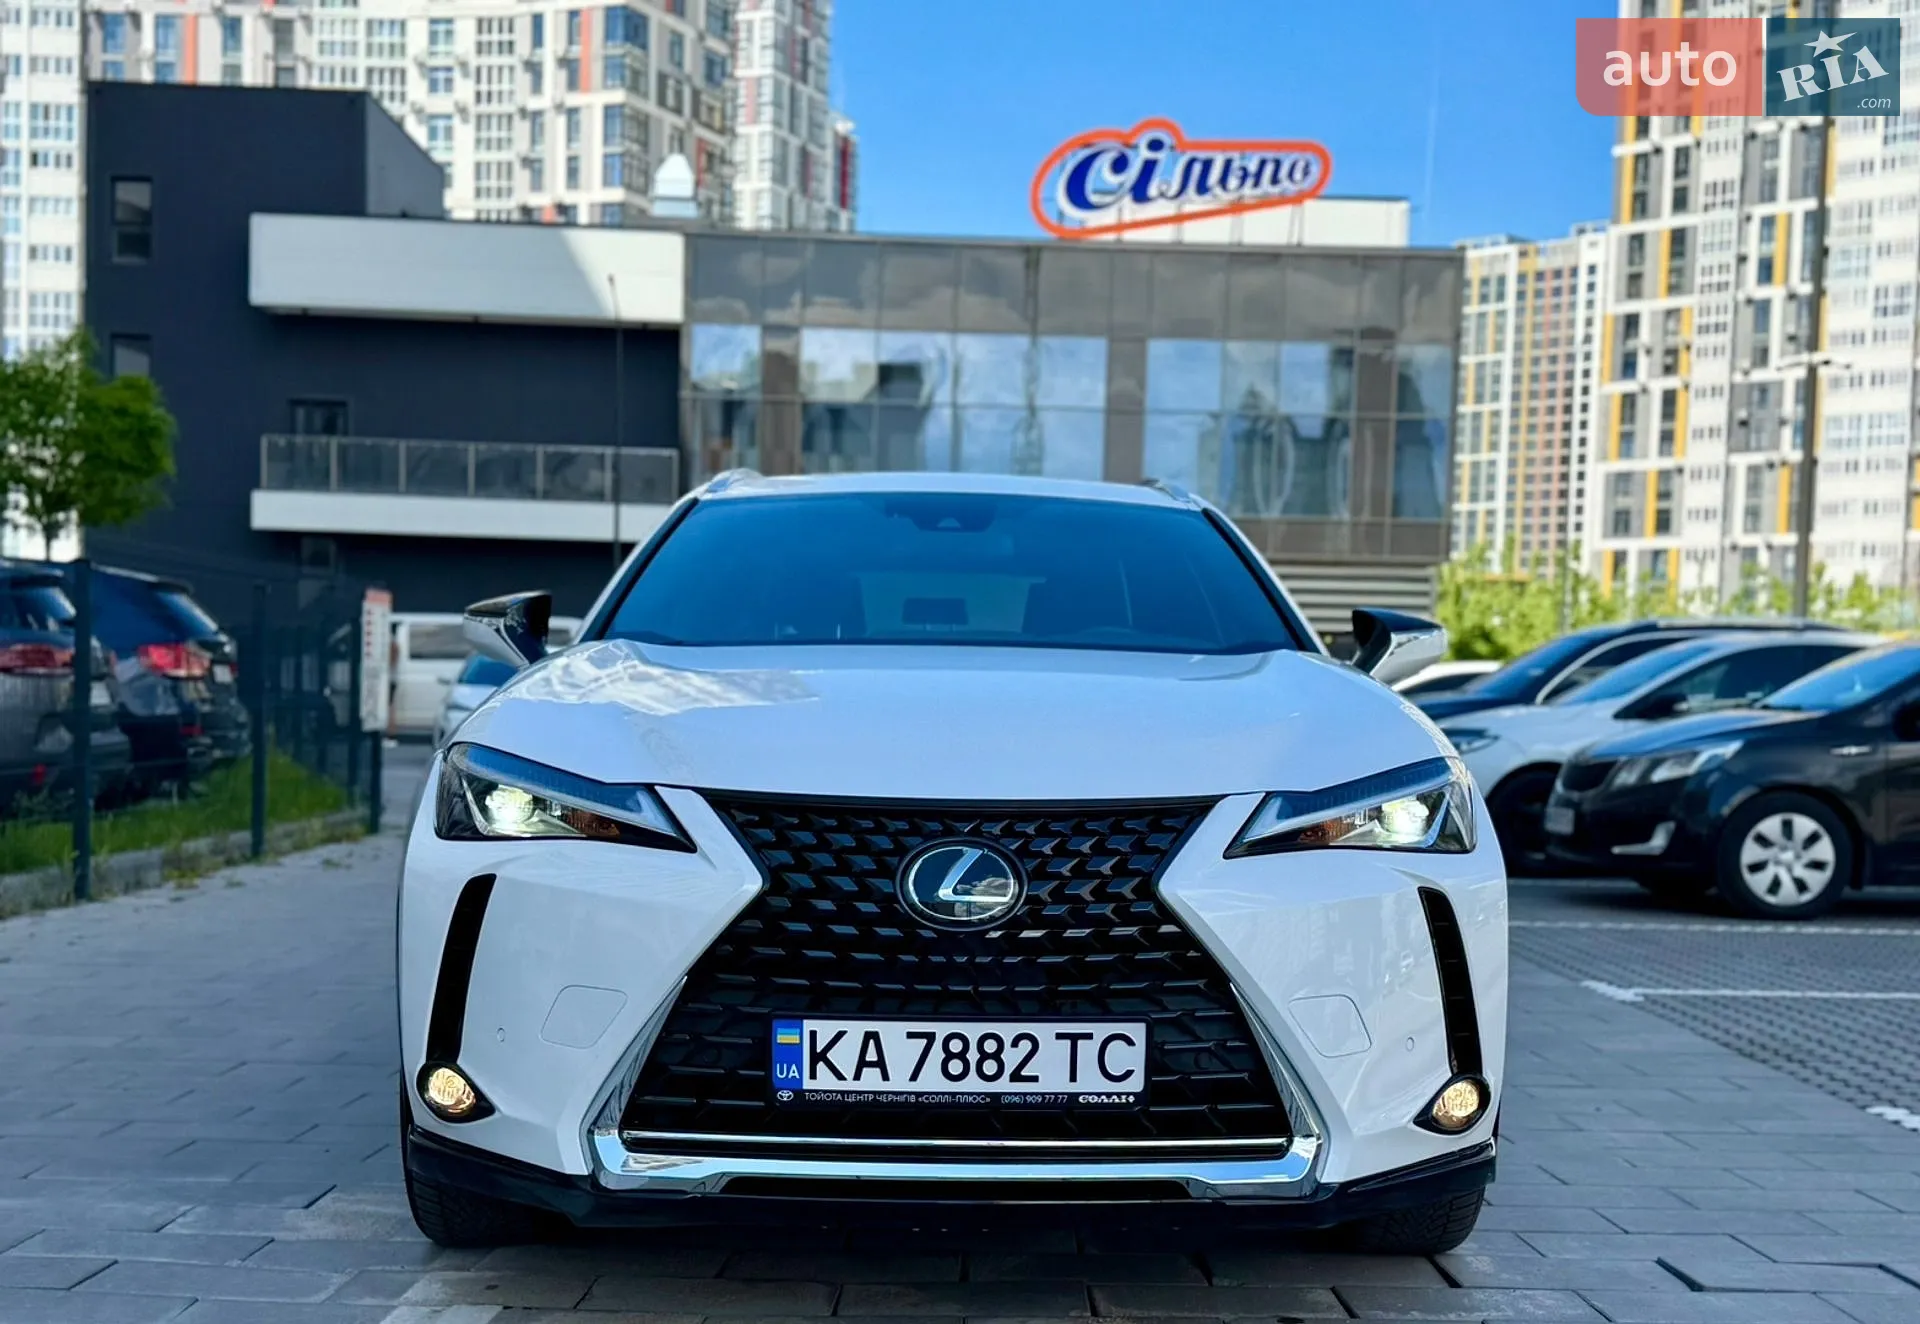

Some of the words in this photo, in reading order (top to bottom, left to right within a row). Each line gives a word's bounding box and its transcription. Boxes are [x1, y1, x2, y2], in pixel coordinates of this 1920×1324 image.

[1060, 135, 1316, 214] Сільпо
[776, 1063, 801, 1079] UA
[905, 1031, 1041, 1083] 7882
[804, 1091, 843, 1102] ТОЙОТА
[844, 1093, 874, 1103] ЦЕНТР
[1000, 1094, 1024, 1104] (096)
[1025, 1094, 1043, 1104] 909
[1043, 1095, 1055, 1104] 77
[1056, 1095, 1068, 1104] 77
